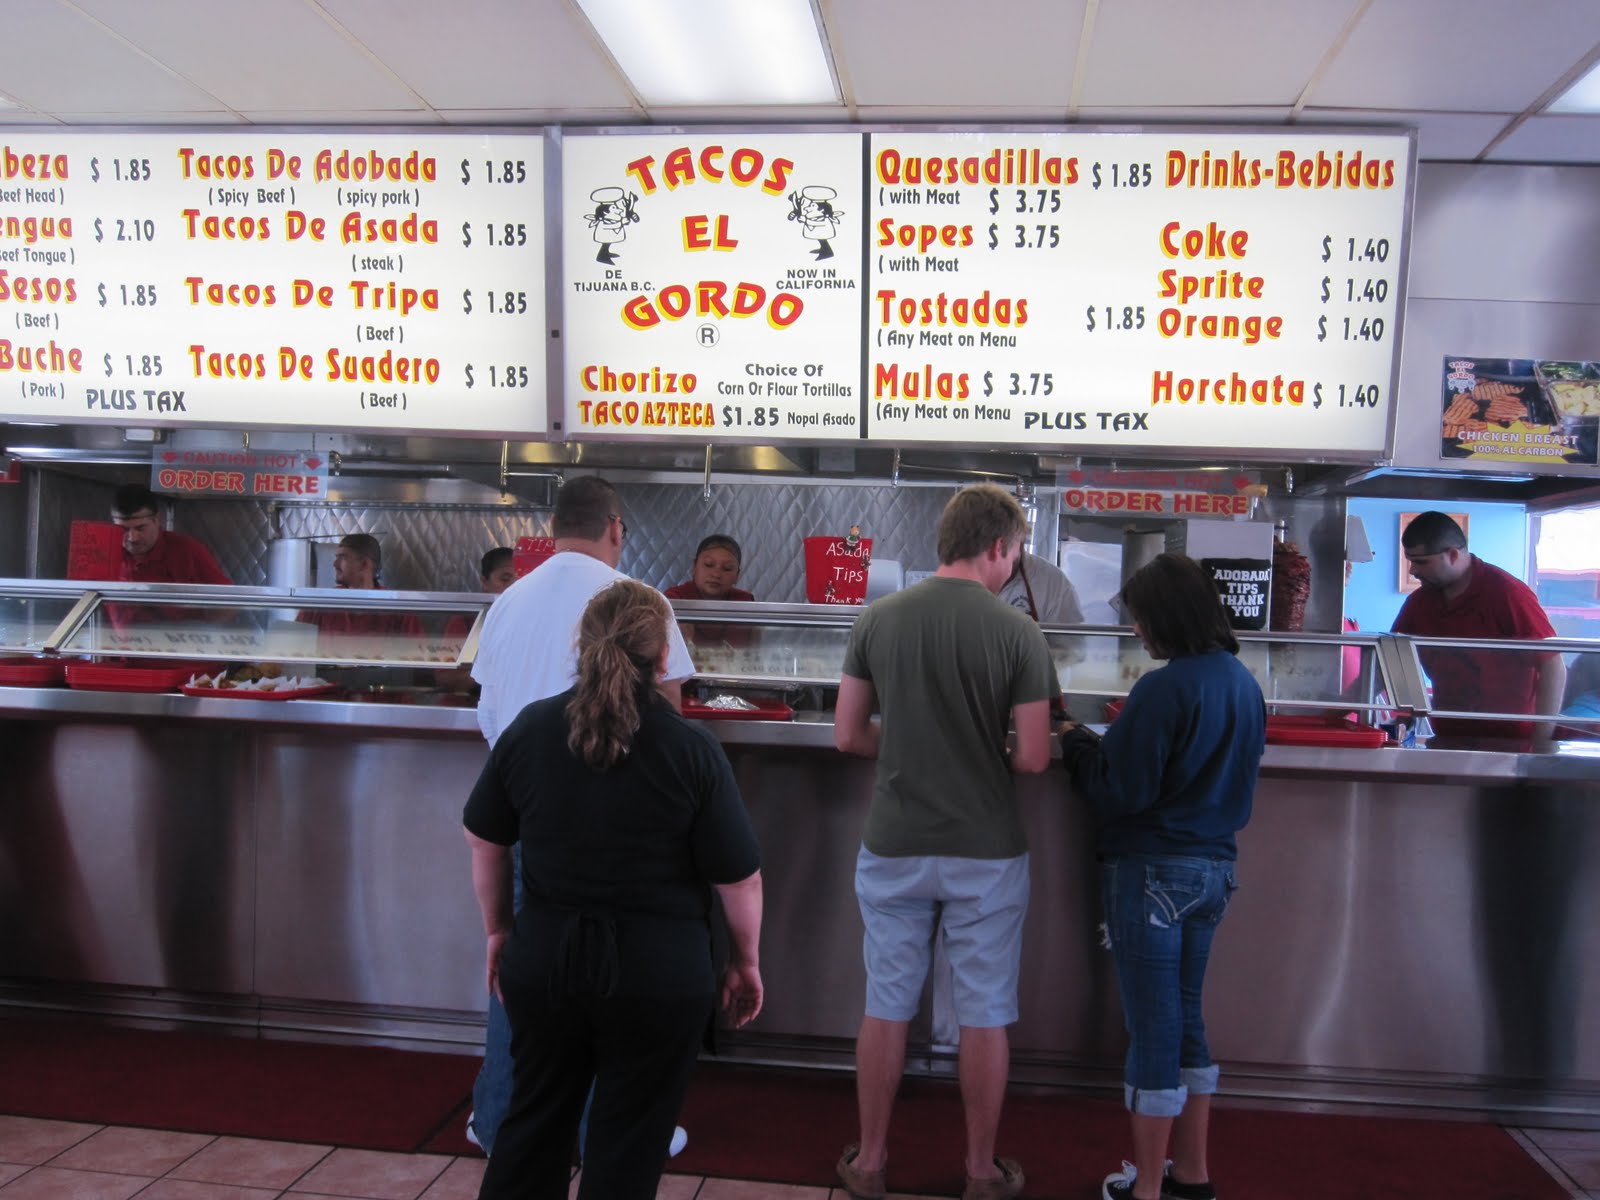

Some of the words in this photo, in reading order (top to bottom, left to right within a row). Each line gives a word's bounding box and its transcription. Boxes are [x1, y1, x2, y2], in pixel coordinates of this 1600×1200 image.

[0, 146, 69, 181] beza
[114, 159, 150, 181] 1.85
[177, 148, 254, 181] Tacos
[266, 149, 301, 180] De
[313, 149, 436, 184] Adobada
[486, 161, 525, 183] 1.85
[625, 146, 794, 196] TACOS
[876, 148, 1078, 185] Quesadillas
[1112, 163, 1151, 187] 1.85
[1165, 150, 1394, 189] Drinks-Bebidas
[0, 189, 20, 203] eef
[927, 189, 960, 204] Meat
[1016, 189, 1060, 213] 3.75
[0, 216, 73, 245] ngua
[117, 220, 154, 241] 2.10
[181, 209, 270, 241] Tacos
[285, 210, 325, 242] De
[340, 212, 438, 245] Asada
[487, 224, 526, 246] 1.85
[681, 214, 738, 252] EL
[877, 218, 973, 255] Sopes
[1015, 225, 1059, 248] 3.75
[0, 248, 19, 262] eef
[1159, 221, 1248, 260] Coke
[1348, 238, 1389, 263] 1.40
[606, 270, 622, 279] DE
[787, 269, 817, 278] NOW
[823, 269, 836, 278] IN
[926, 256, 959, 272] Meat
[0, 269, 77, 304] Sesos
[121, 285, 156, 306] 1.85
[184, 277, 276, 307] Tacos
[291, 279, 333, 308] De
[348, 280, 438, 317] Tripa
[488, 291, 526, 314] 1.85
[574, 282, 627, 291] TIJUANA
[631, 282, 655, 291] B.C.
[776, 280, 855, 289] CALIFORNIA
[1157, 269, 1264, 305] Sprite
[1347, 279, 1388, 303] 1.40
[620, 280, 804, 331] GORDO
[876, 290, 1028, 328] Tostadas
[1106, 306, 1145, 329] 1.85
[920, 331, 953, 346] Meat
[958, 335, 974, 346] on
[980, 332, 1016, 347] Menu
[1157, 308, 1283, 346] Orange
[1344, 317, 1384, 341] 1.40
[0, 339, 83, 374] Buche
[126, 355, 162, 376] 1.85
[188, 345, 265, 380] Tacos
[278, 346, 313, 381] De
[325, 348, 440, 385] Suadero
[489, 366, 528, 388] 1.85
[745, 364, 797, 376] Choice
[804, 364, 823, 376] Of
[580, 366, 697, 394] Chorizo
[718, 381, 744, 395] Corn
[749, 382, 762, 395] Or
[768, 382, 798, 396] Flour
[802, 383, 851, 396] Tortillas
[874, 363, 969, 401] Mulas
[1010, 373, 1053, 396] 3.75
[1151, 371, 1304, 406] Horchata
[1339, 385, 1379, 408] 1.40
[86, 389, 136, 410] PLUS
[143, 390, 186, 413] TAX
[577, 400, 639, 427] TACO
[641, 402, 715, 428] AZTECA
[723, 405, 779, 427] $1.85
[788, 412, 818, 427] Nopal
[823, 413, 855, 426] Asado
[915, 404, 948, 419] Meat
[953, 408, 969, 419] on
[975, 405, 1010, 420] Menu
[1024, 412, 1087, 429] PLUS
[1096, 413, 1148, 432] TAX
[1457, 431, 1520, 442] CHICKEN
[1525, 434, 1579, 445] BREAST
[1473, 445, 1500, 453] 100%
[1503, 446, 1516, 454] AL
[1518, 447, 1563, 456] CARBON
[263, 456, 298, 468] HOT
[159, 469, 245, 493] ORDER
[254, 473, 319, 495] HERE
[1064, 489, 1164, 513] ORDER
[1173, 493, 1249, 515] HERE
[527, 538, 556, 552] TIP
[833, 566, 863, 583] Tips
[1219, 594, 1264, 605] THANK
[1227, 582, 1258, 594] TIPS
[1231, 605, 1259, 617] YOU
